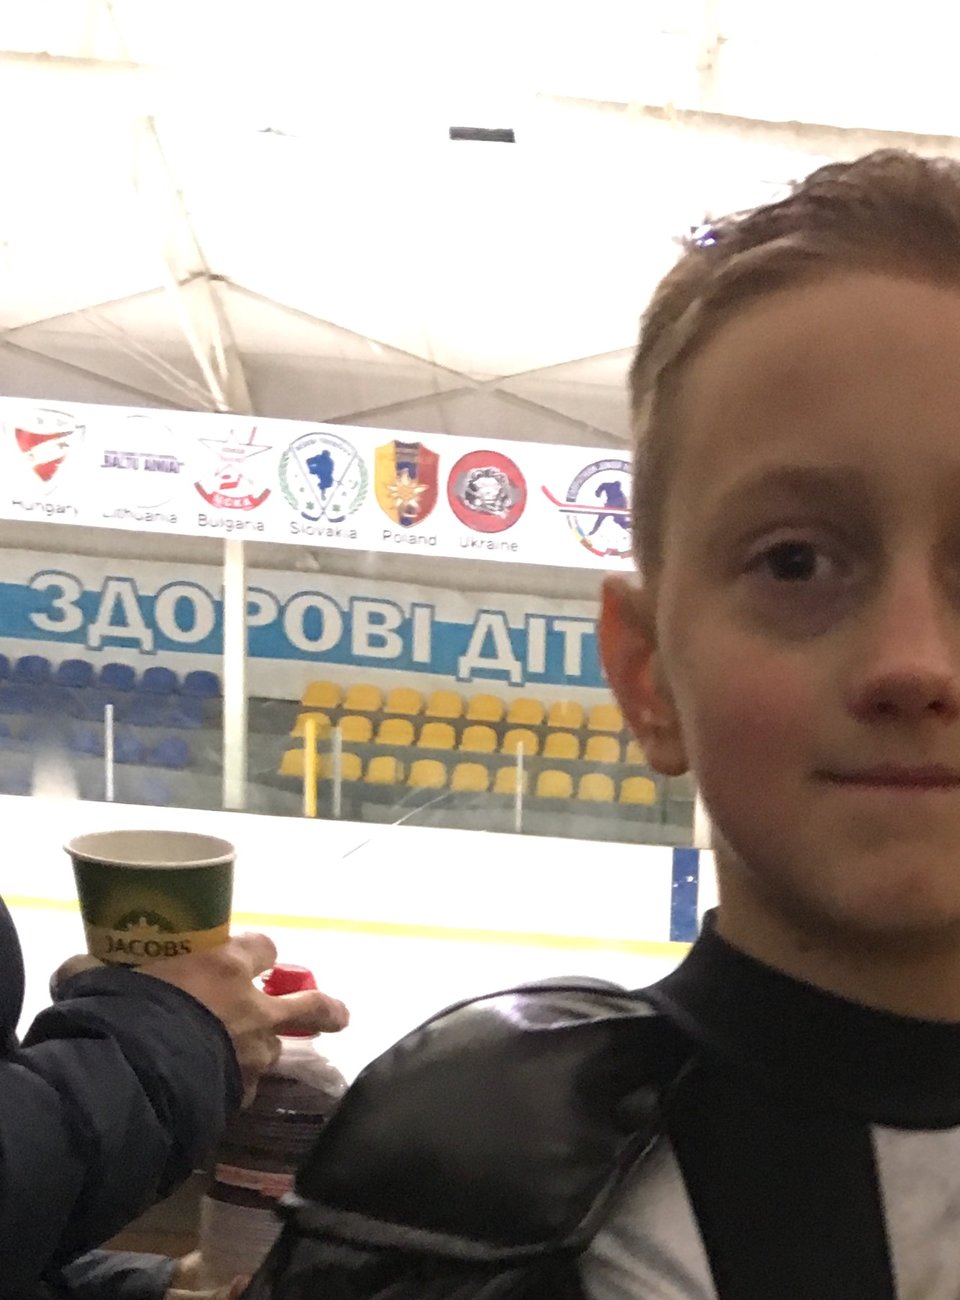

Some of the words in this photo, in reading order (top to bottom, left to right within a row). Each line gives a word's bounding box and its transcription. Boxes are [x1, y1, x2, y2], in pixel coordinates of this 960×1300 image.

[290, 520, 358, 540] Slovakia
[382, 529, 437, 547] Poland
[459, 535, 519, 552] Ukraine
[455, 608, 599, 687] ДІТ
[105, 934, 192, 958] JACOBS
